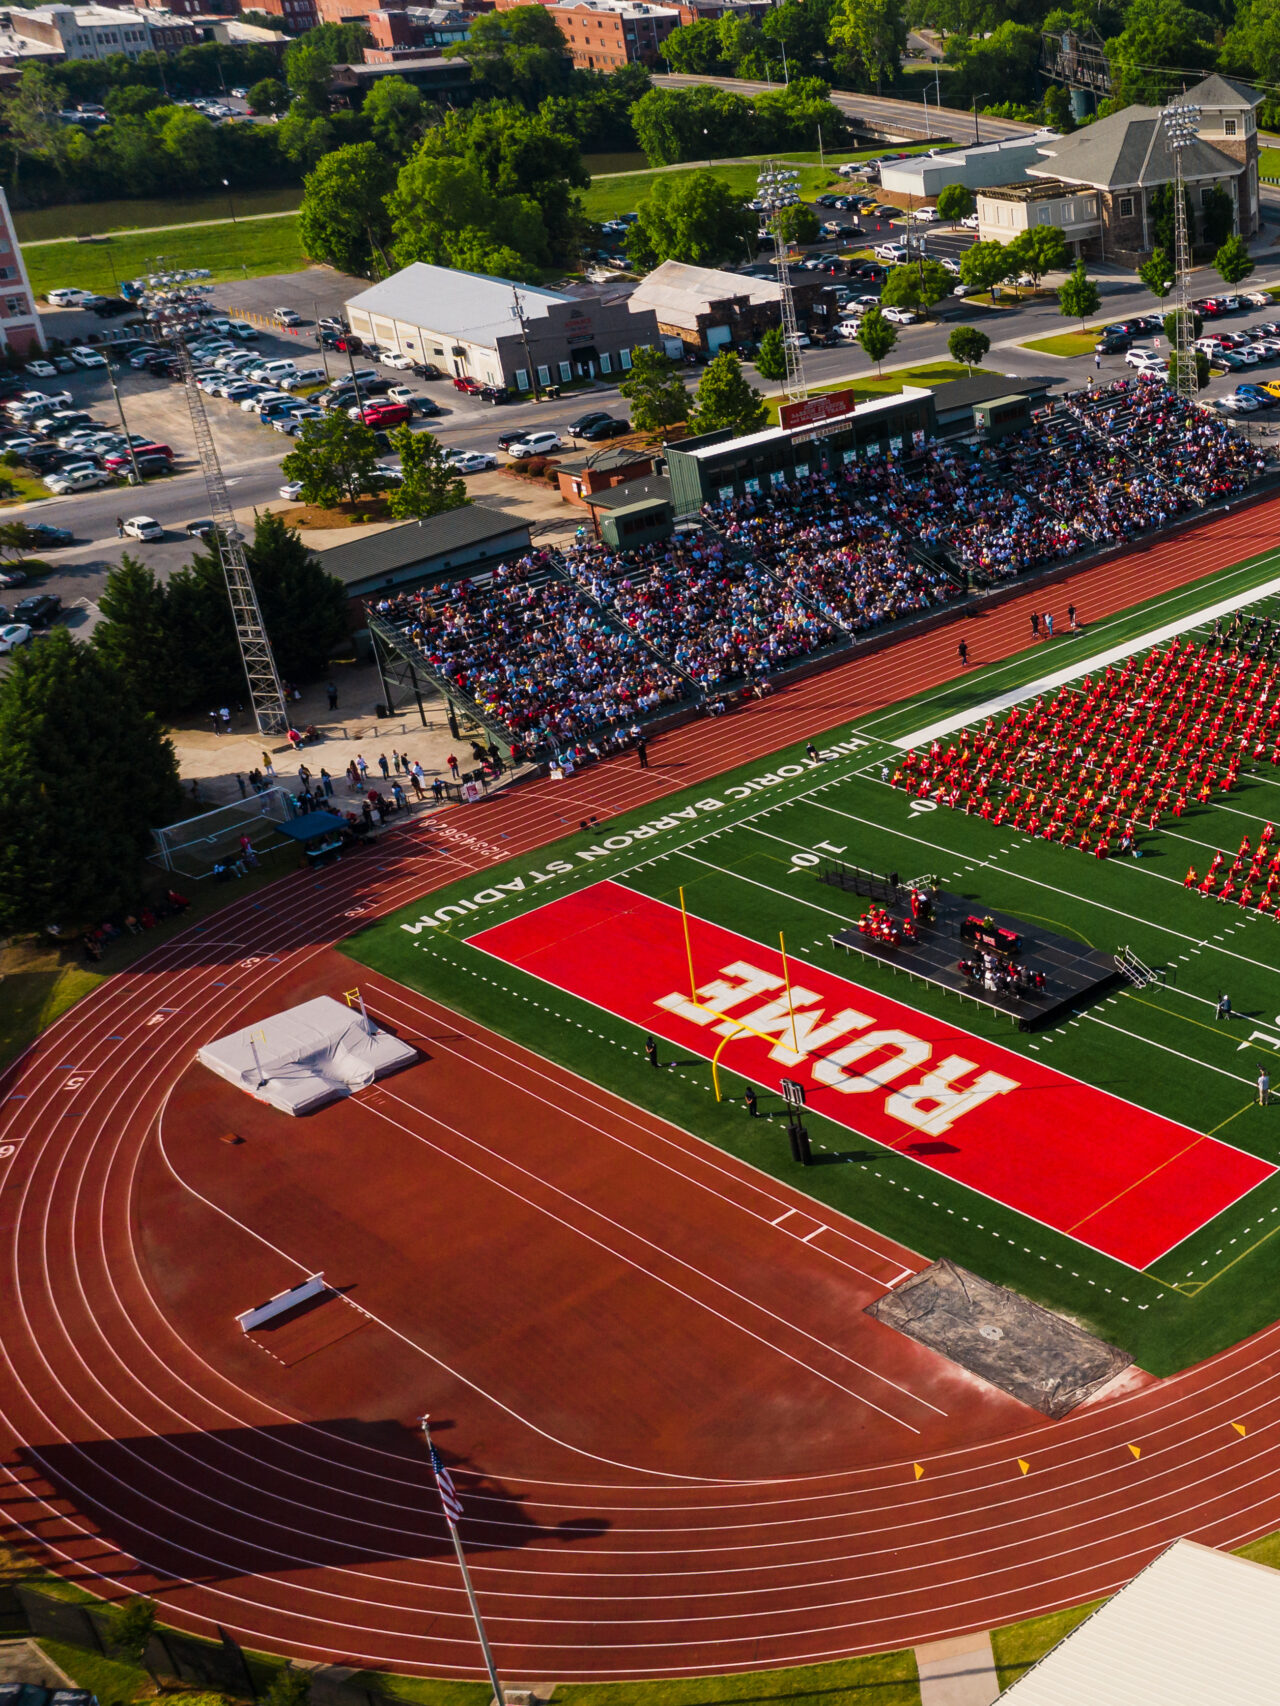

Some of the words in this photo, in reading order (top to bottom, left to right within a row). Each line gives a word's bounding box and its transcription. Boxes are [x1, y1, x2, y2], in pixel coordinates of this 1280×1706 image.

[724, 737, 870, 799] HISTORIC
[575, 797, 726, 863] BARRON
[790, 840, 848, 866] 10
[399, 859, 574, 935] STADIUM
[652, 960, 1022, 1137] ROME
